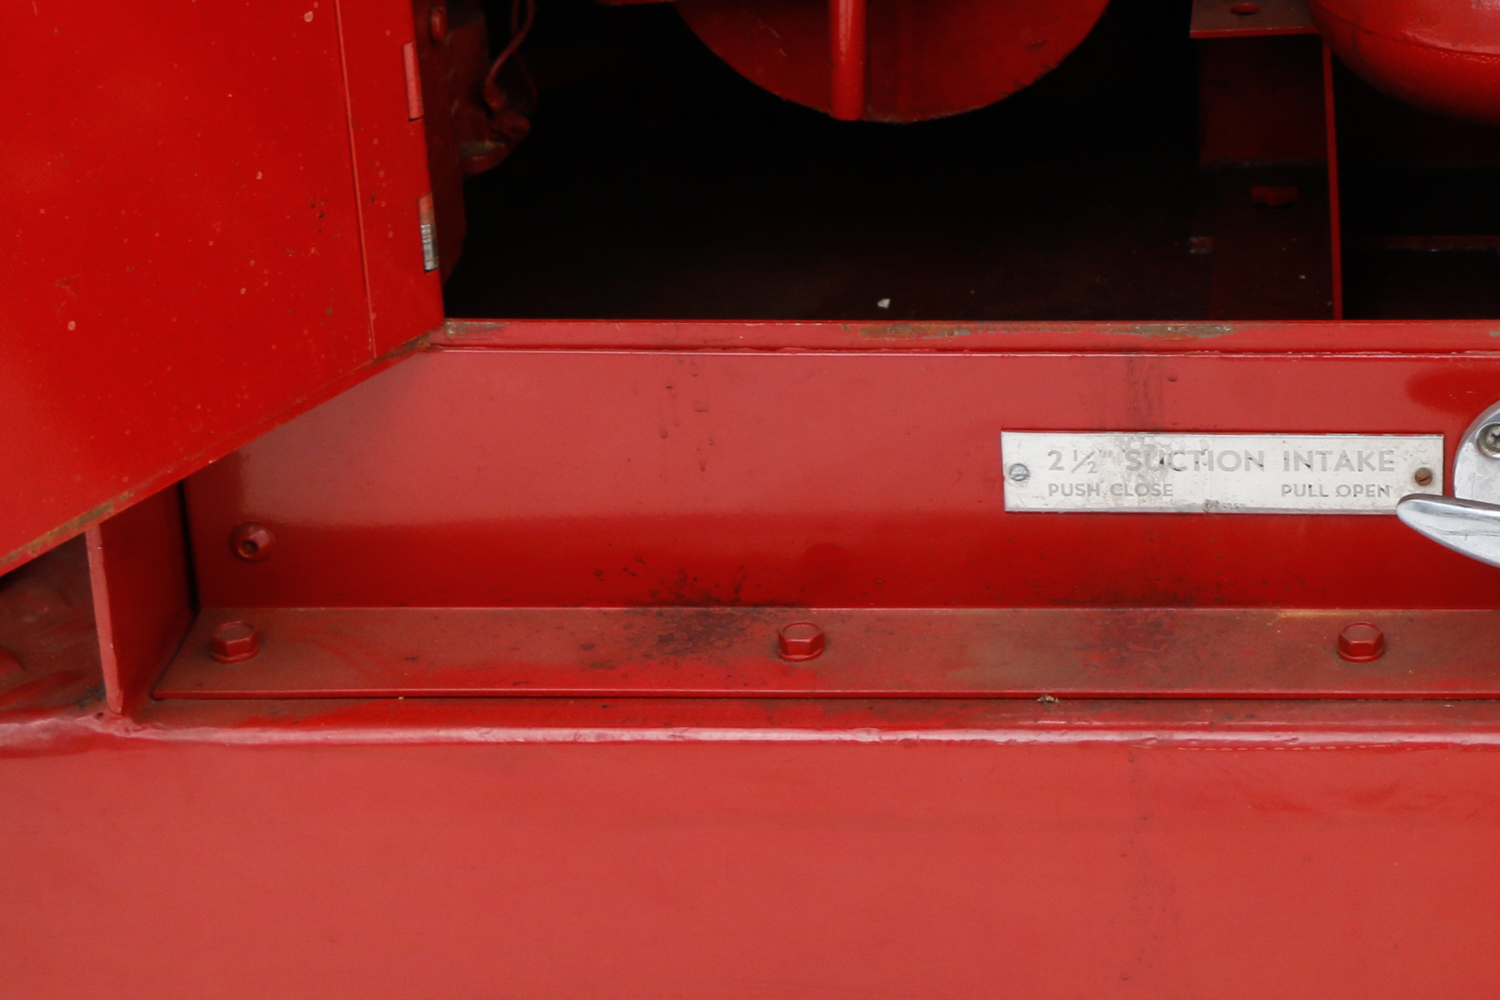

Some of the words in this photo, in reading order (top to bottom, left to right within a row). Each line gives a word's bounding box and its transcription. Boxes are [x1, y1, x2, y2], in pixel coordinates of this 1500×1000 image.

[1125, 449, 1264, 472] SUCTION
[1283, 450, 1395, 472] INTAKE
[1048, 483, 1100, 497] PUSH
[1110, 483, 1174, 497] CLOSE
[1281, 484, 1328, 497] PULL
[1336, 484, 1391, 498] OPEN
